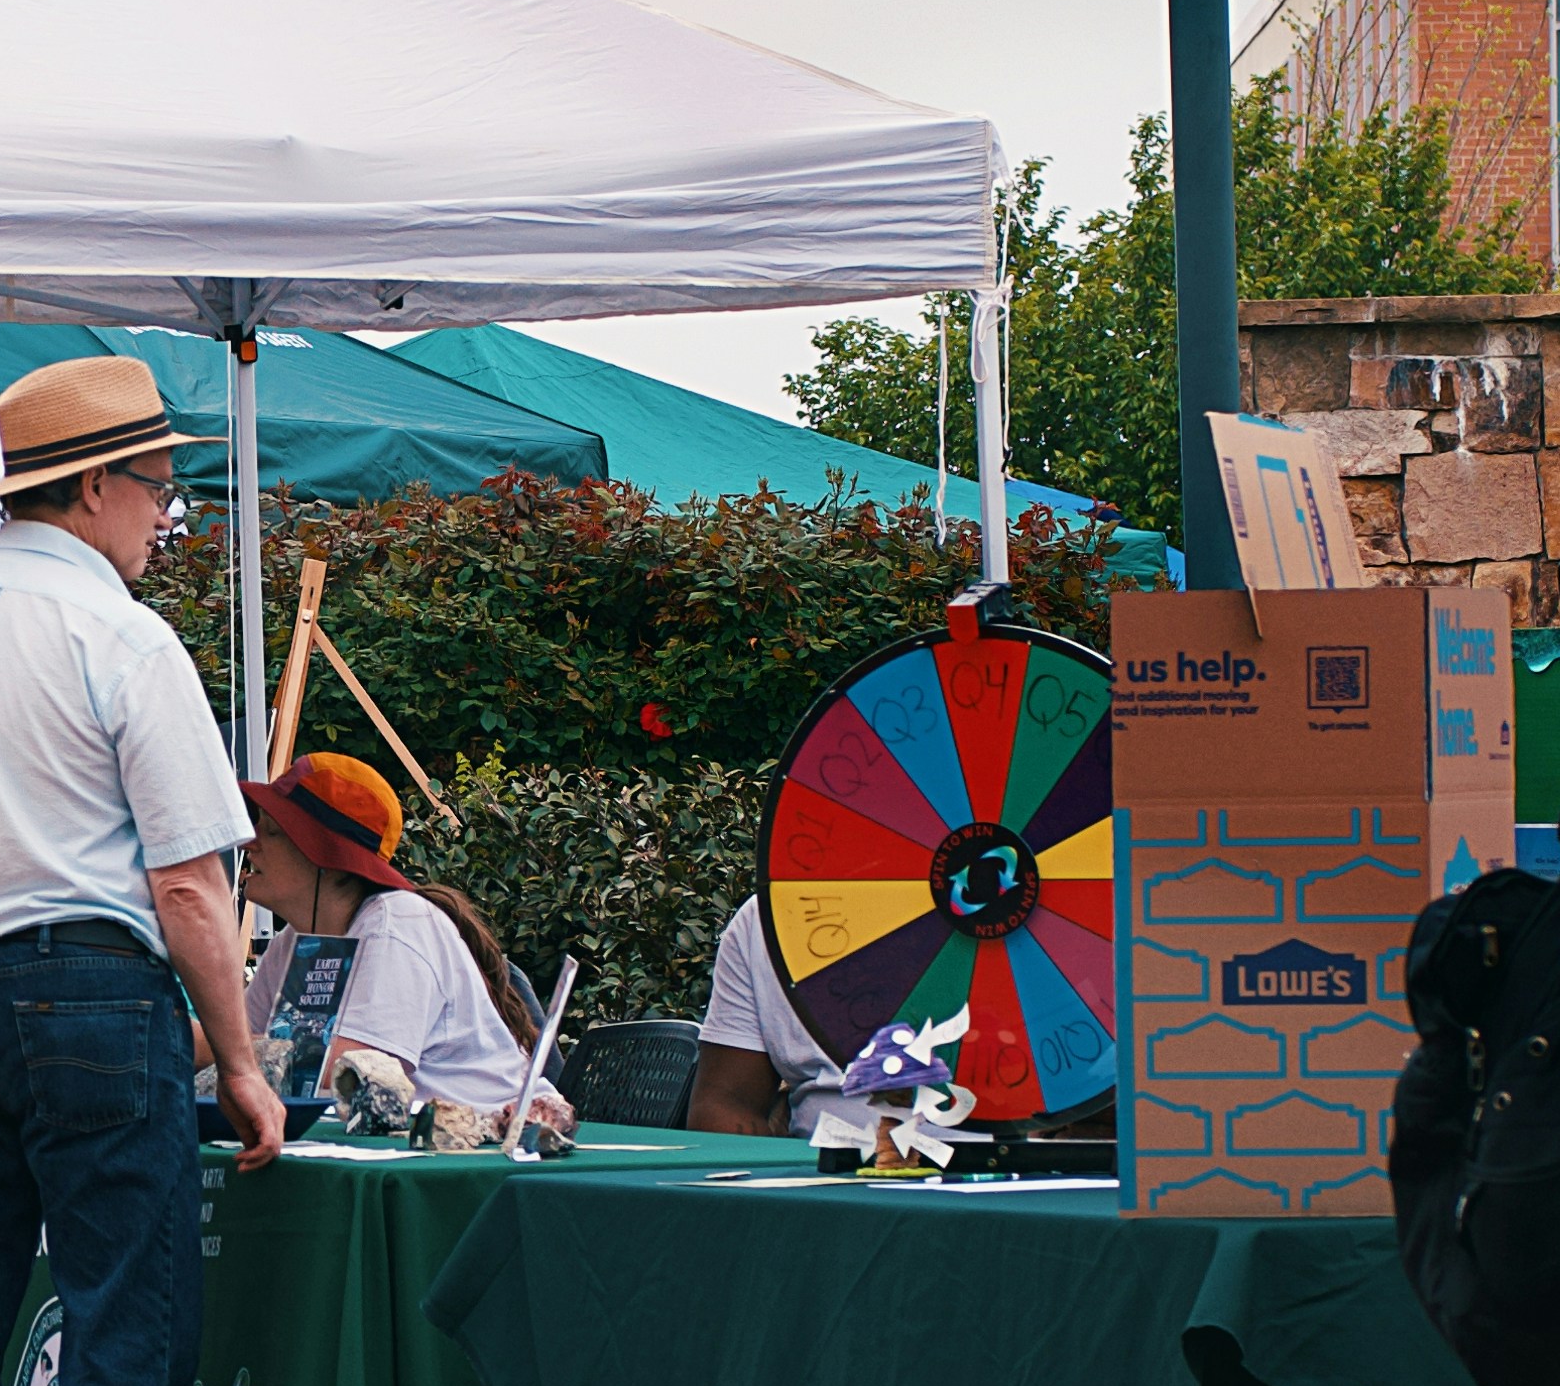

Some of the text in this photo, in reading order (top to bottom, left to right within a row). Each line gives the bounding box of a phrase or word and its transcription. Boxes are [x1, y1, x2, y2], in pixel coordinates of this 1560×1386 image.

[949, 660, 1009, 720] Q4
[1126, 659, 1168, 683] us
[1176, 650, 1267, 688] help.
[871, 684, 939, 744] Q3
[1026, 673, 1098, 738] Q5
[1114, 705, 1139, 717] and
[1203, 689, 1250, 703] moving
[818, 731, 884, 797] Q2
[786, 810, 835, 871] Q1
[1237, 965, 1353, 998] LOWE'S
[200, 1167, 226, 1192] ARTH,
